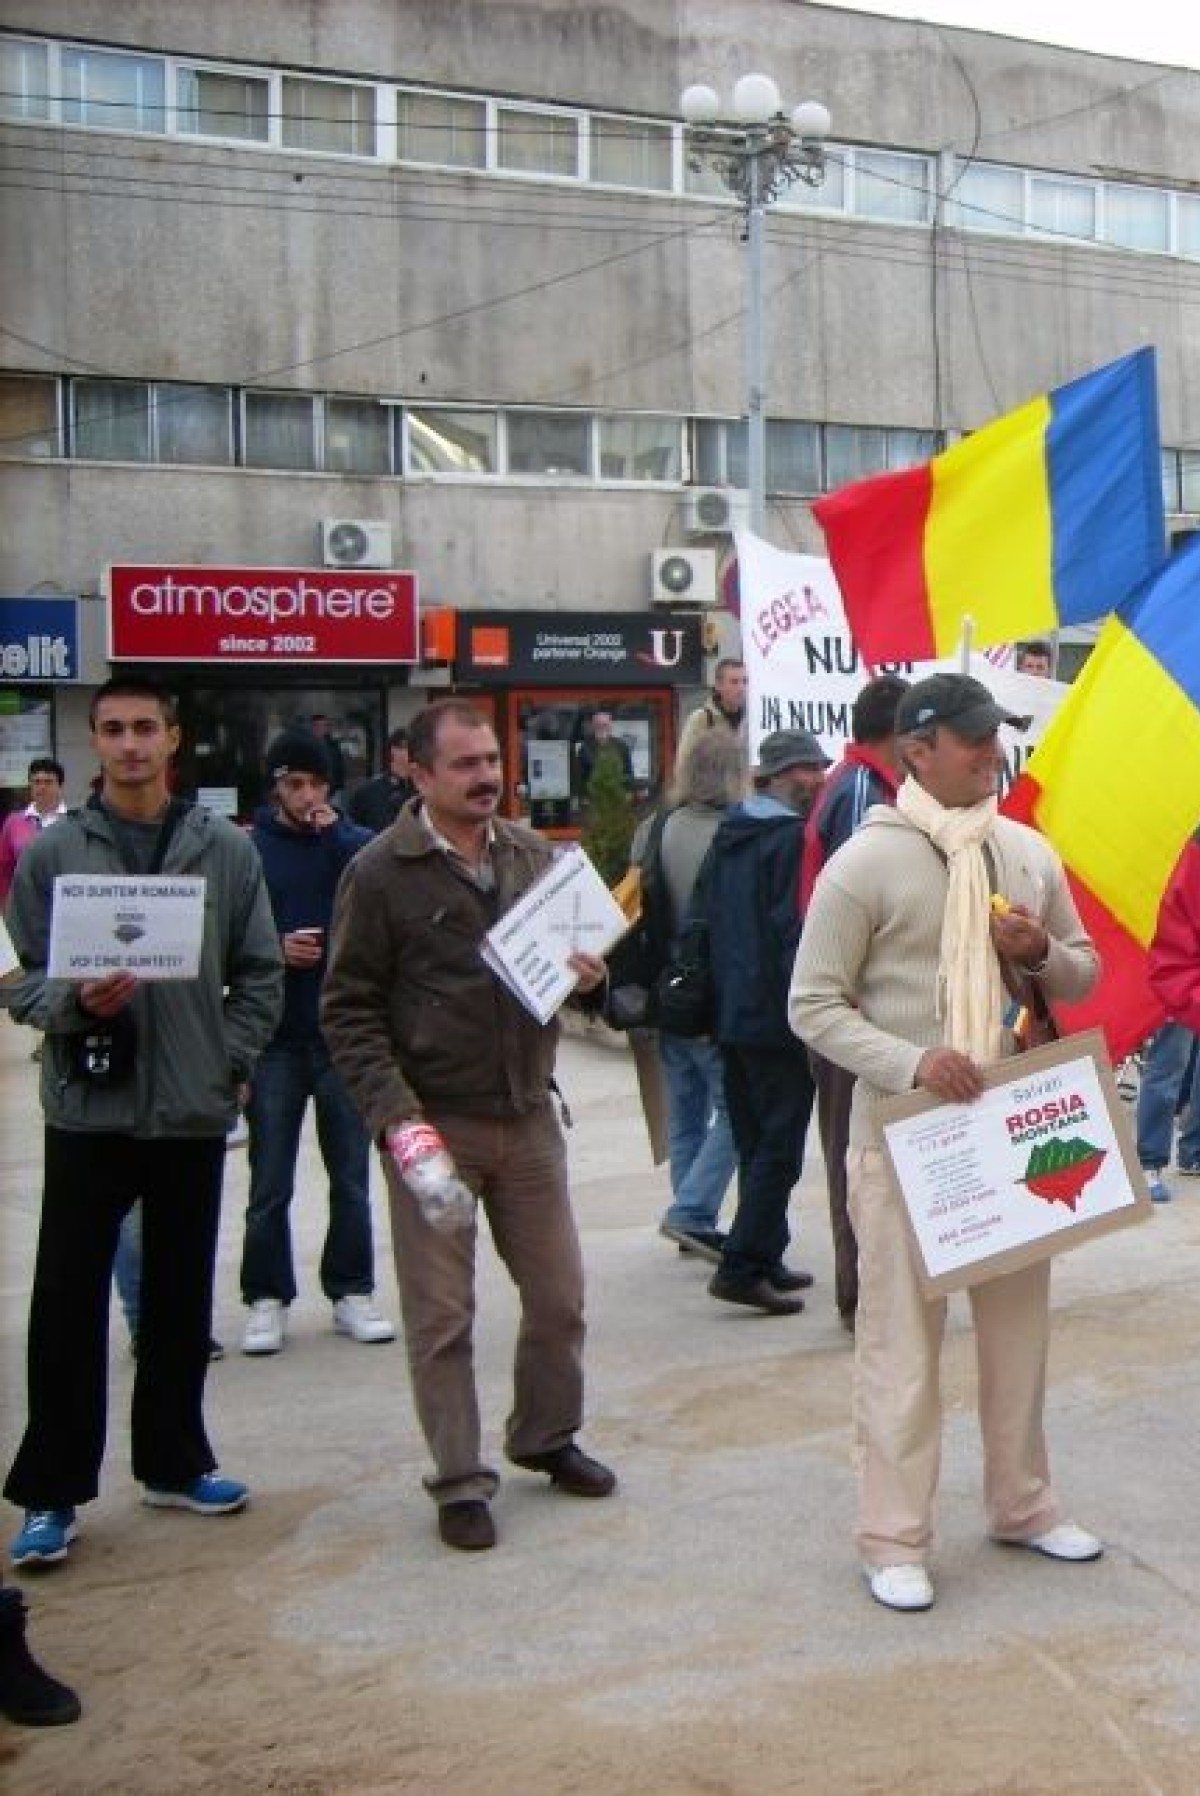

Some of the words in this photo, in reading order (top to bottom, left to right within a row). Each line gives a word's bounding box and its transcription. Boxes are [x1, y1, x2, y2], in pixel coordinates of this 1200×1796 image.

[129, 575, 395, 624] atmosphere
[753, 584, 828, 658] LEGEA
[0, 635, 70, 677] elit
[219, 634, 268, 652] since
[271, 635, 315, 652] 2002
[533, 648, 581, 662] partener
[584, 648, 627, 662] Orange
[536, 633, 589, 646] Universal
[648, 630, 685, 666] U
[1005, 1094, 1086, 1135] ROSIA
[1010, 1110, 1091, 1146] MONTANA
